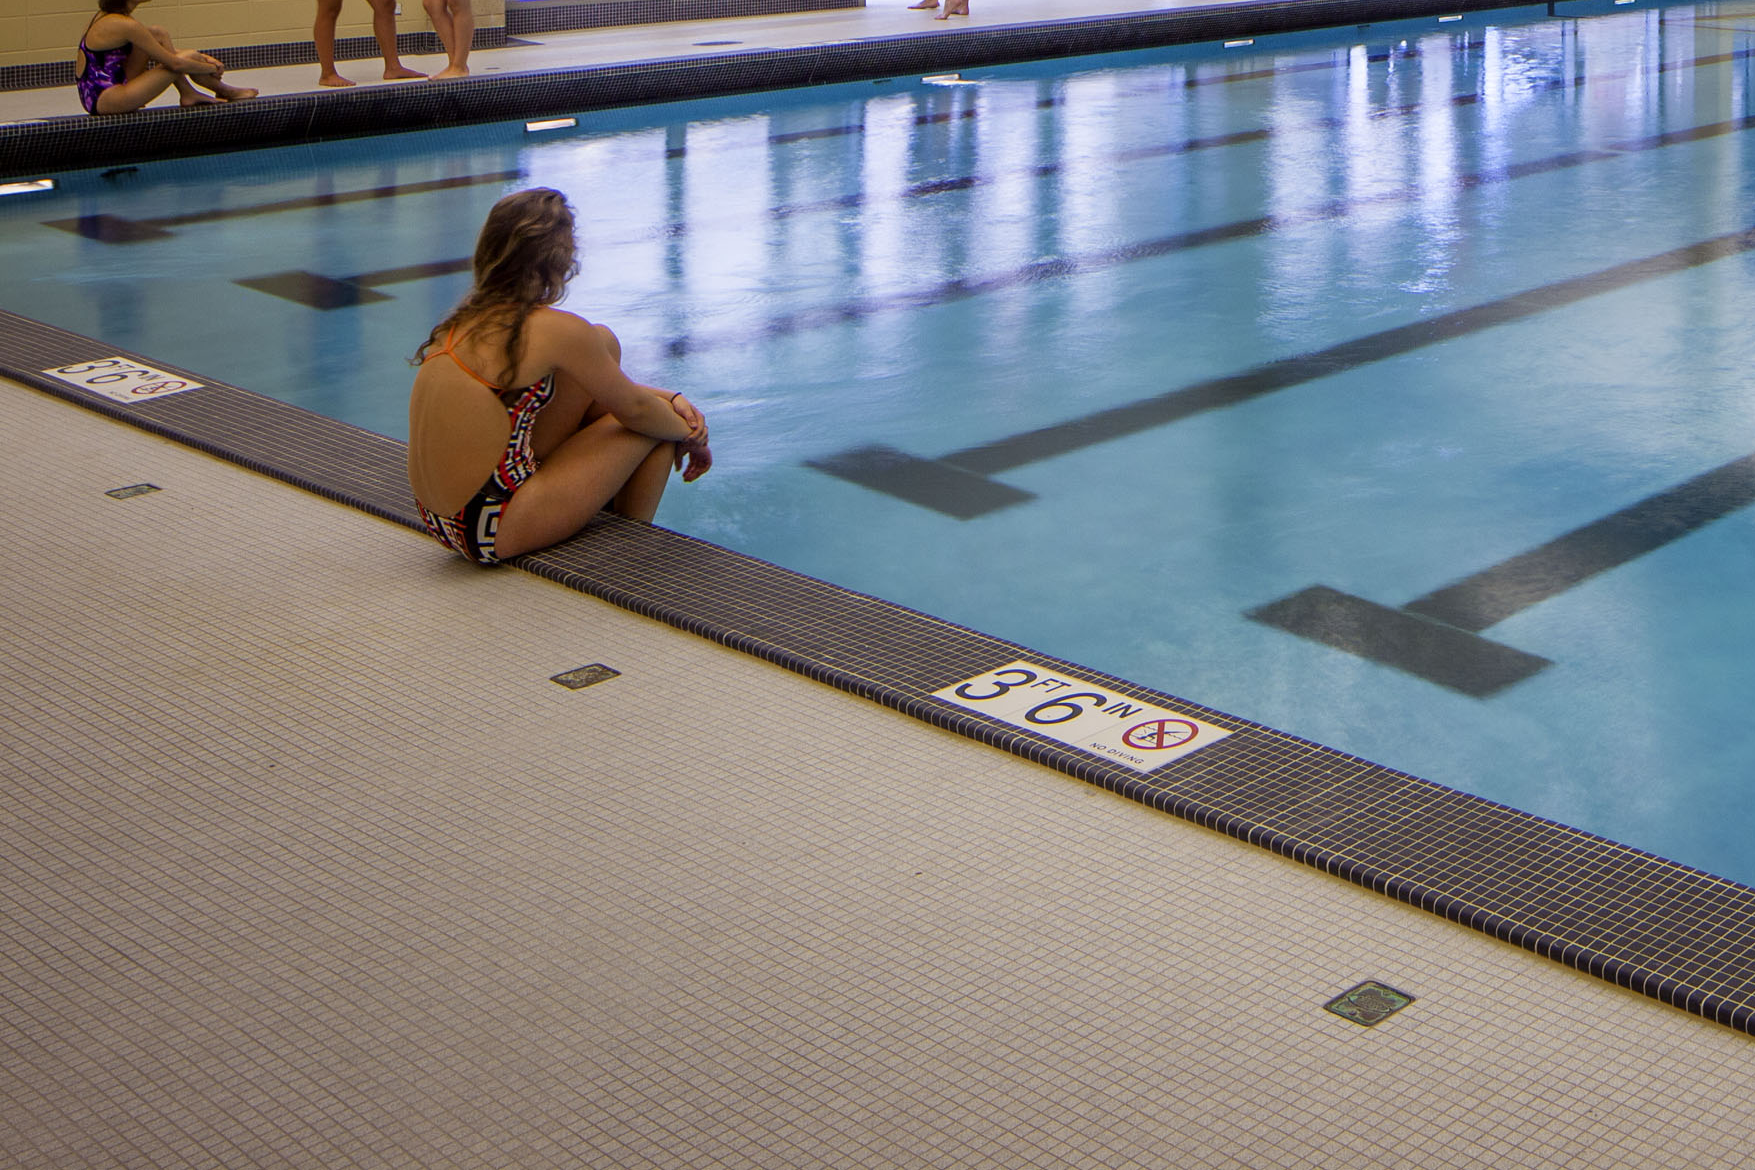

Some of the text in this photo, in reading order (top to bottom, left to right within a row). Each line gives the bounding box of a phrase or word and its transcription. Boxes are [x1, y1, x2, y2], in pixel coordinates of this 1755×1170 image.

[57, 360, 120, 374] 3
[86, 370, 150, 384] 6
[954, 669, 1143, 725] 3 FT 6 IN
[1089, 742, 1145, 764] NO DIVING
